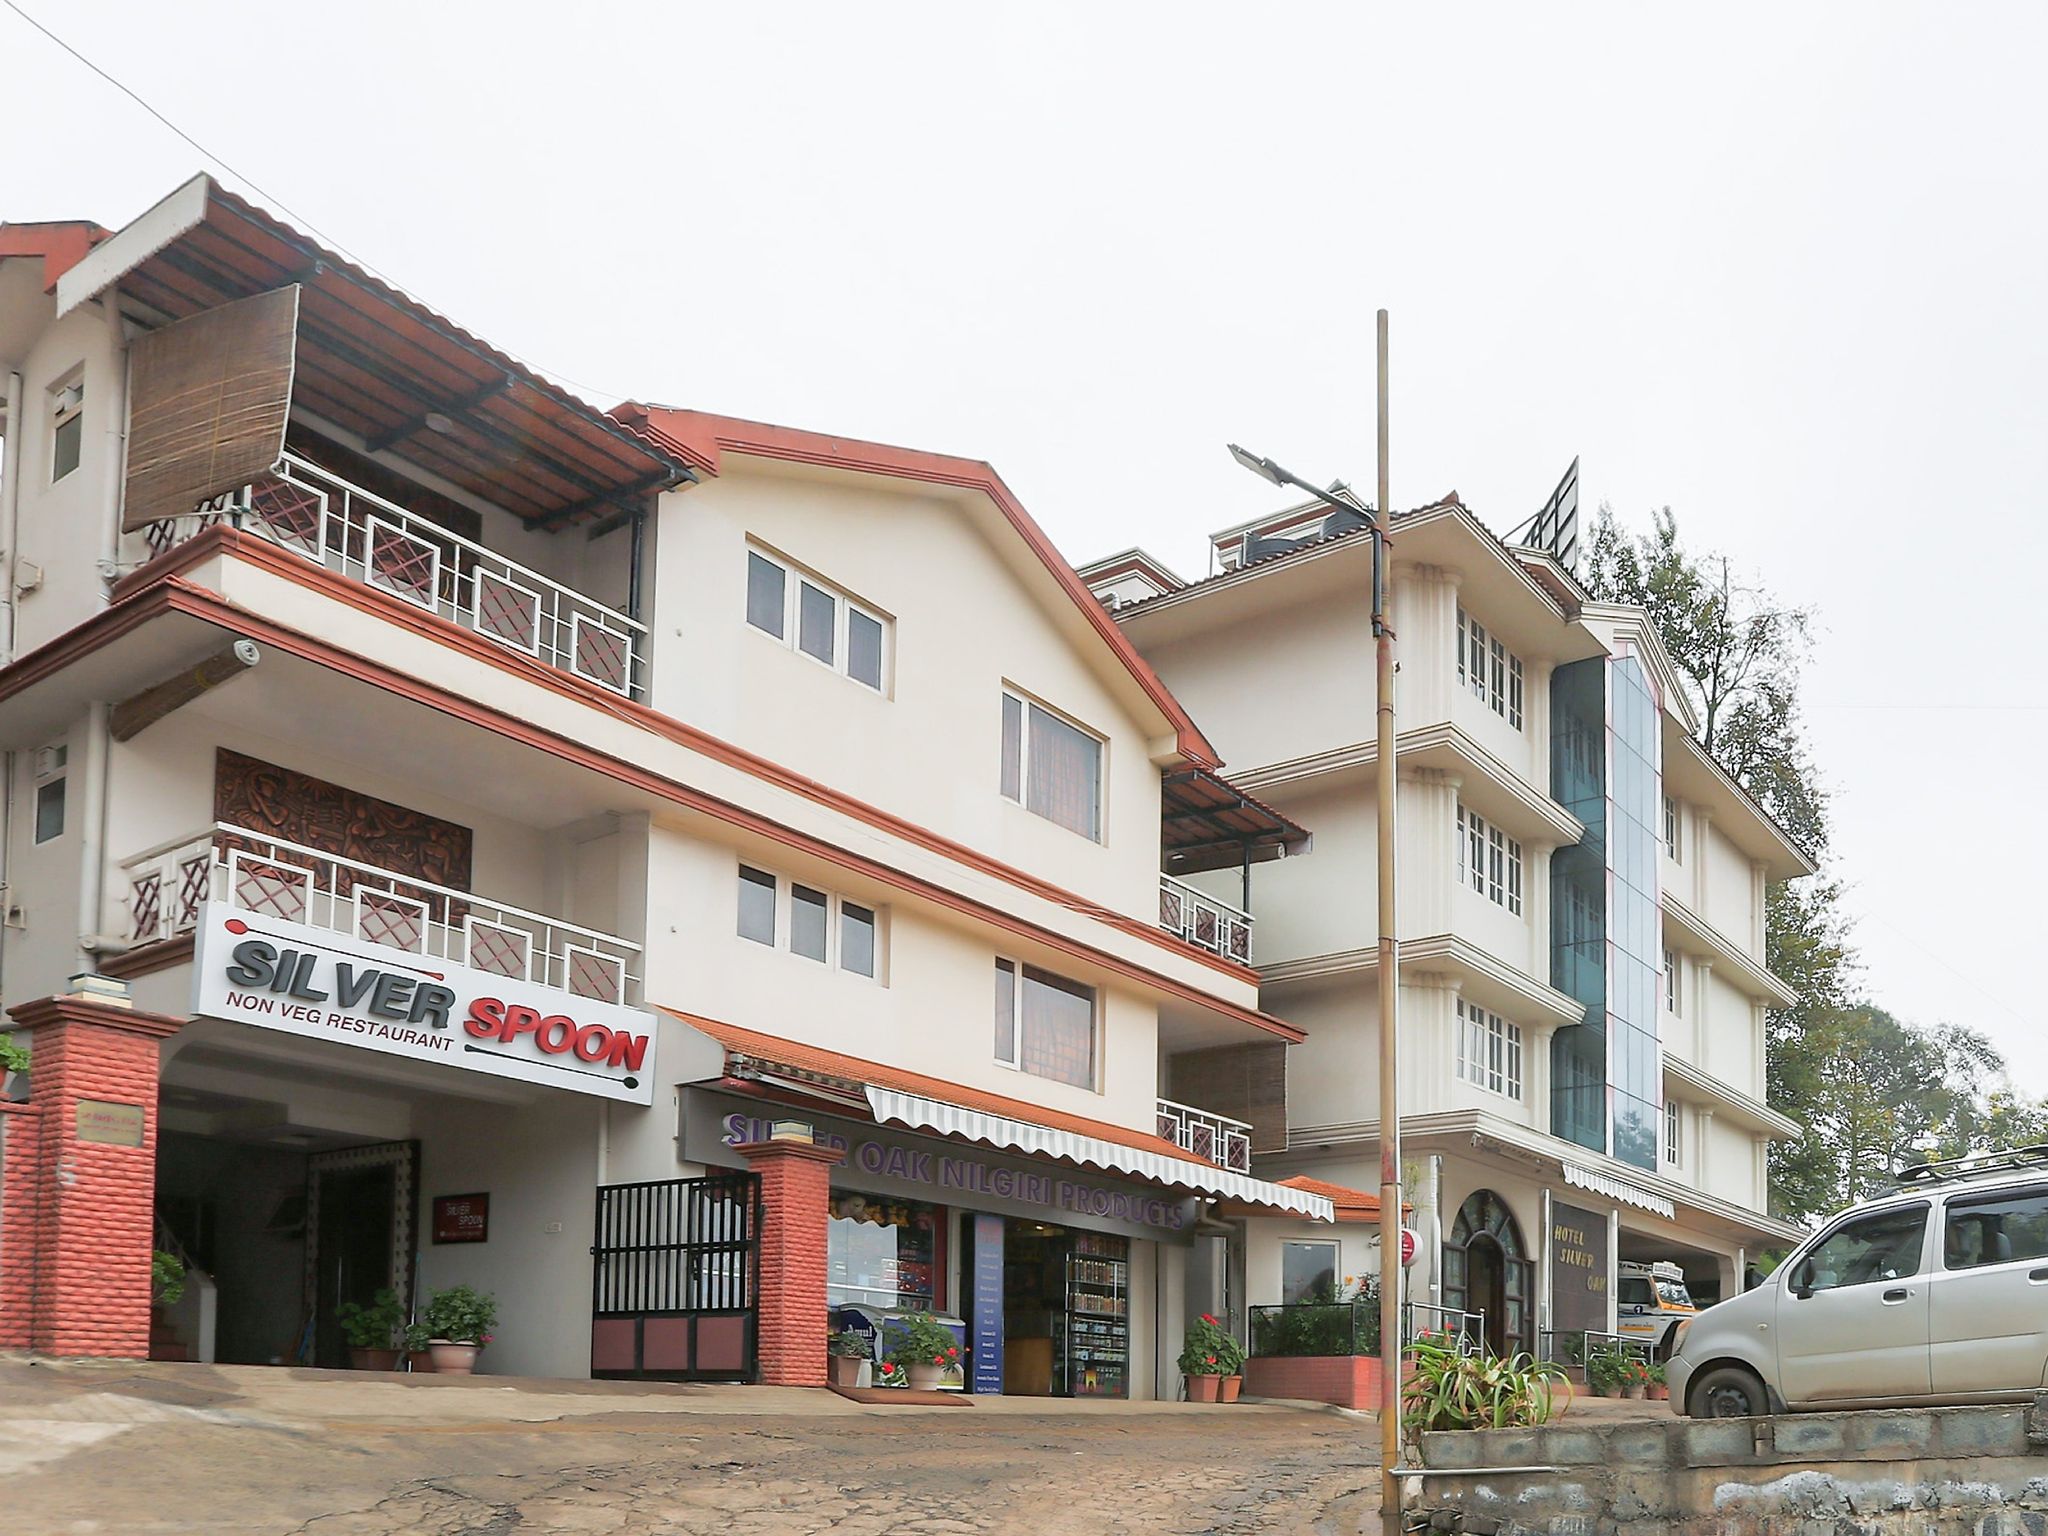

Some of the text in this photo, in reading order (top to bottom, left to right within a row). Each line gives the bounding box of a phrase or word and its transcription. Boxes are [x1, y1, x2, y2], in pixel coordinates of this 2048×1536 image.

[226, 940, 649, 1072] SILVER SPOON
[226, 991, 455, 1052] NON VEG RESTAURANT
[856, 1141, 932, 1183] OAK
[938, 1157, 1053, 1205] NILGIRI
[1060, 1179, 1184, 1232] PRODUCTS
[1554, 1224, 1584, 1246] HOTEL
[1560, 1248, 1594, 1269] SILVER
[1587, 1274, 1606, 1293] OAK
